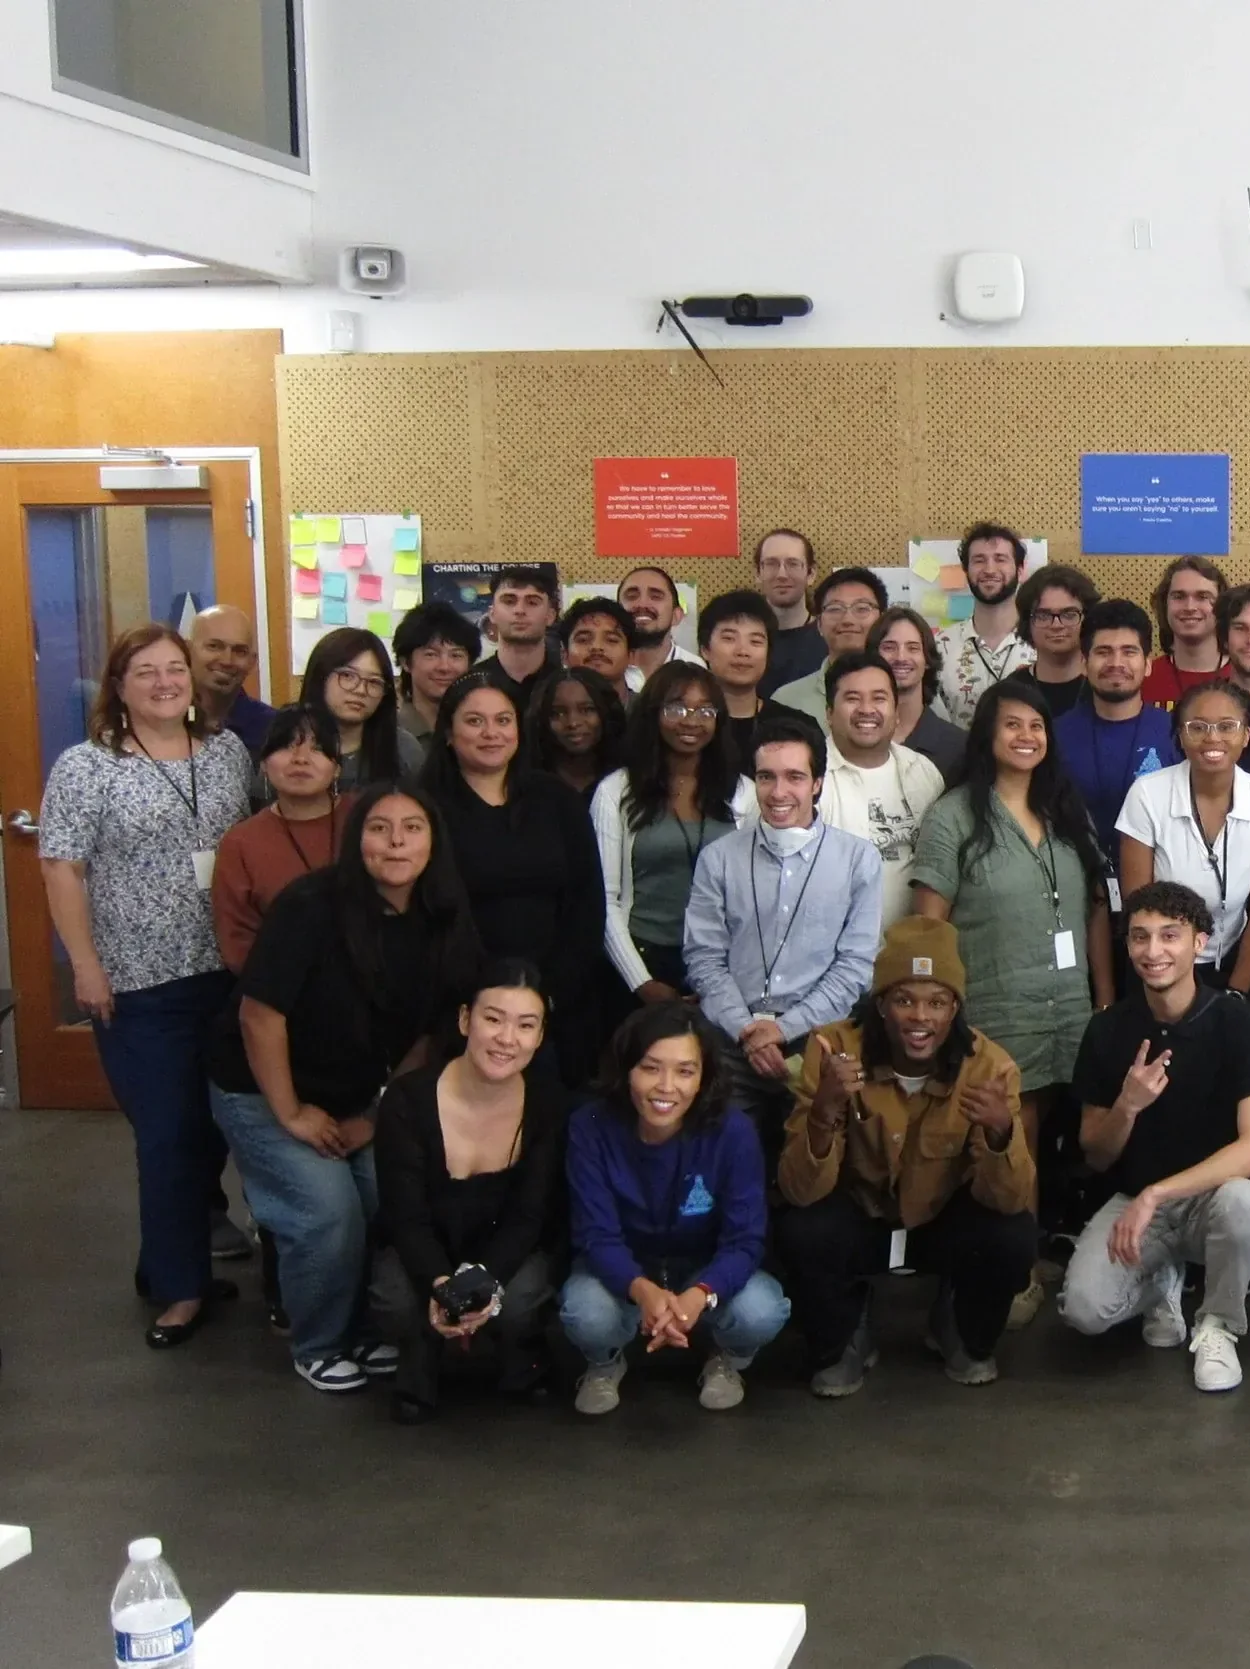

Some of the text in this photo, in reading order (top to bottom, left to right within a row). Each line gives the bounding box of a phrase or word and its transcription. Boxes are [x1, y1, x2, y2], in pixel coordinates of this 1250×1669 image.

[1092, 505, 1107, 513] sure
[1108, 505, 1121, 513] you
[1122, 505, 1142, 513] aren't
[1143, 505, 1166, 513] saying
[1191, 505, 1219, 513] yourself.
[432, 563, 481, 573] CHARTING
[482, 563, 500, 572] THE
